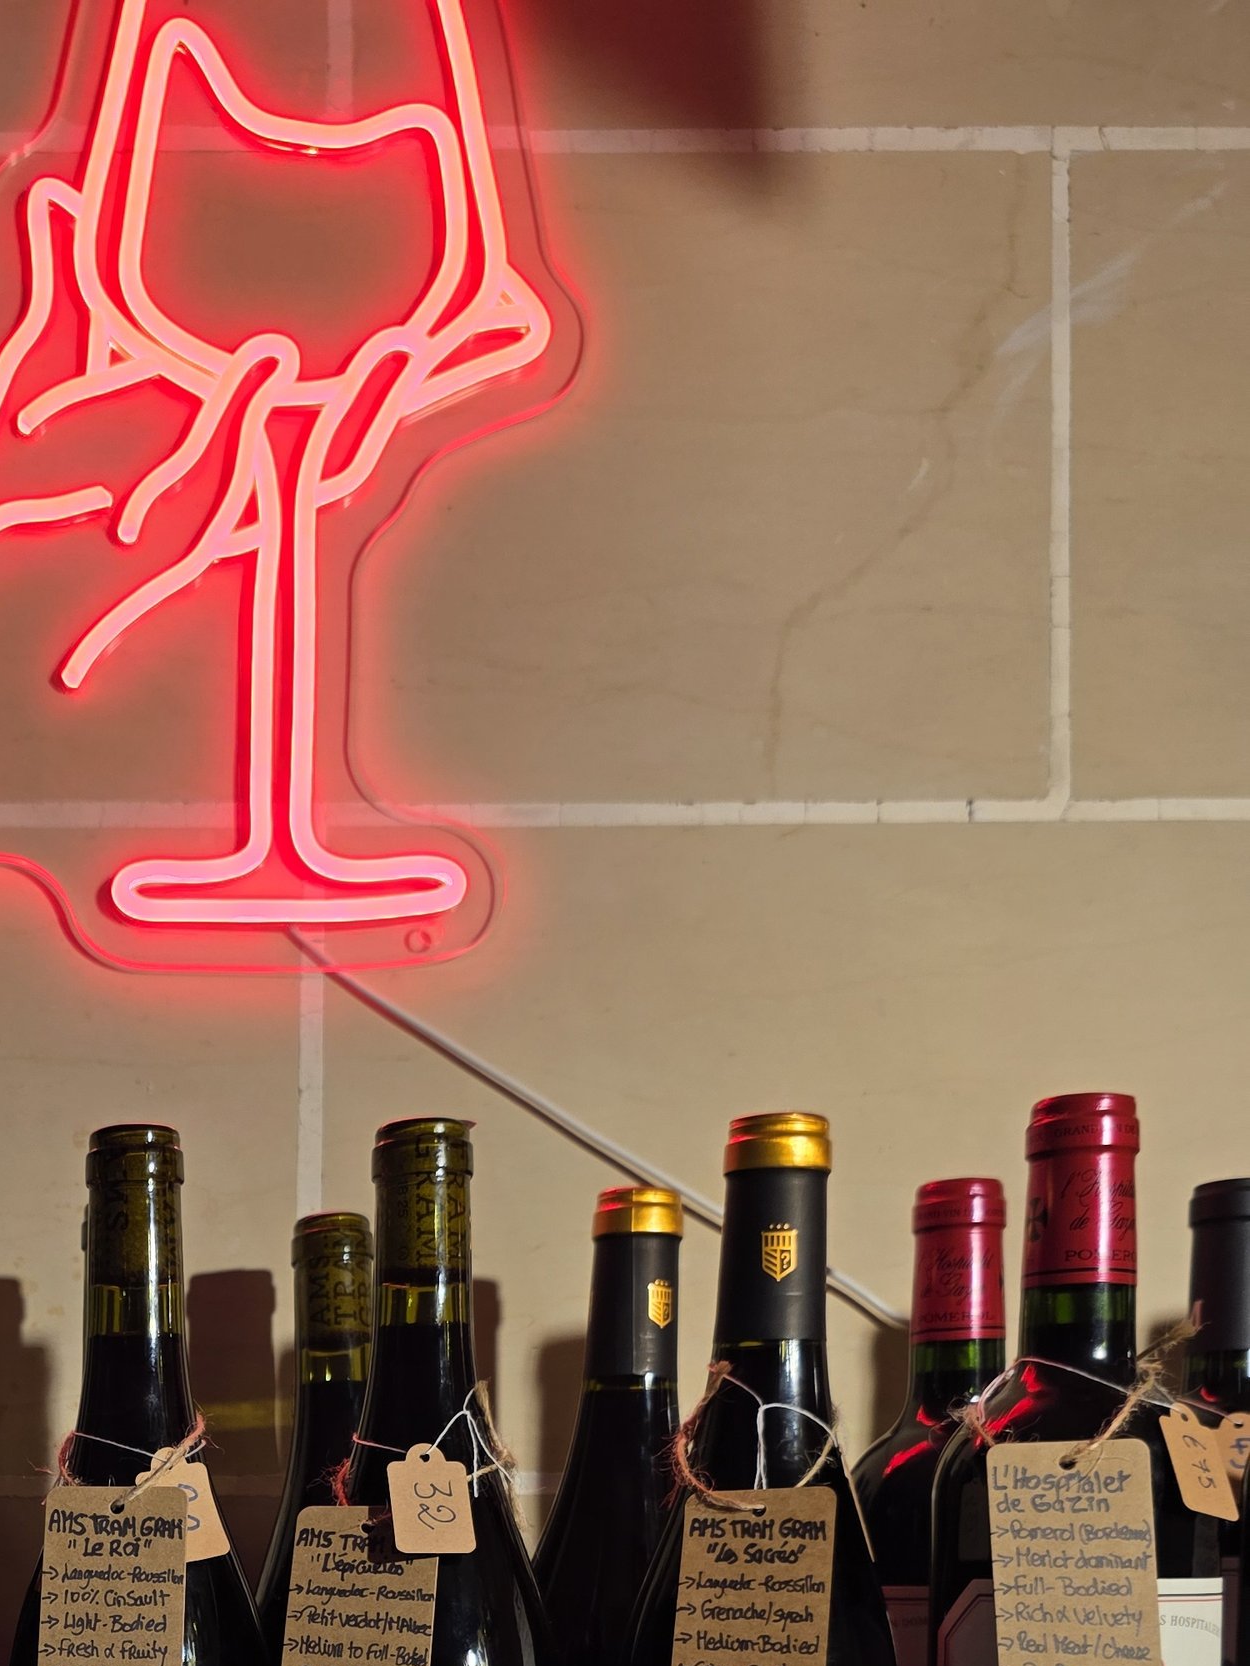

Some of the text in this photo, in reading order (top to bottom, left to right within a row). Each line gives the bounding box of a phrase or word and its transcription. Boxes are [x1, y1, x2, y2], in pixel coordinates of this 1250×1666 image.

[48, 1509, 183, 1539] AMS TRAM GRAM
[730, 1518, 775, 1539] TRAM
[778, 1518, 826, 1540] GRAM
[1015, 1604, 1051, 1623] Rich
[59, 1639, 98, 1658] Fresh
